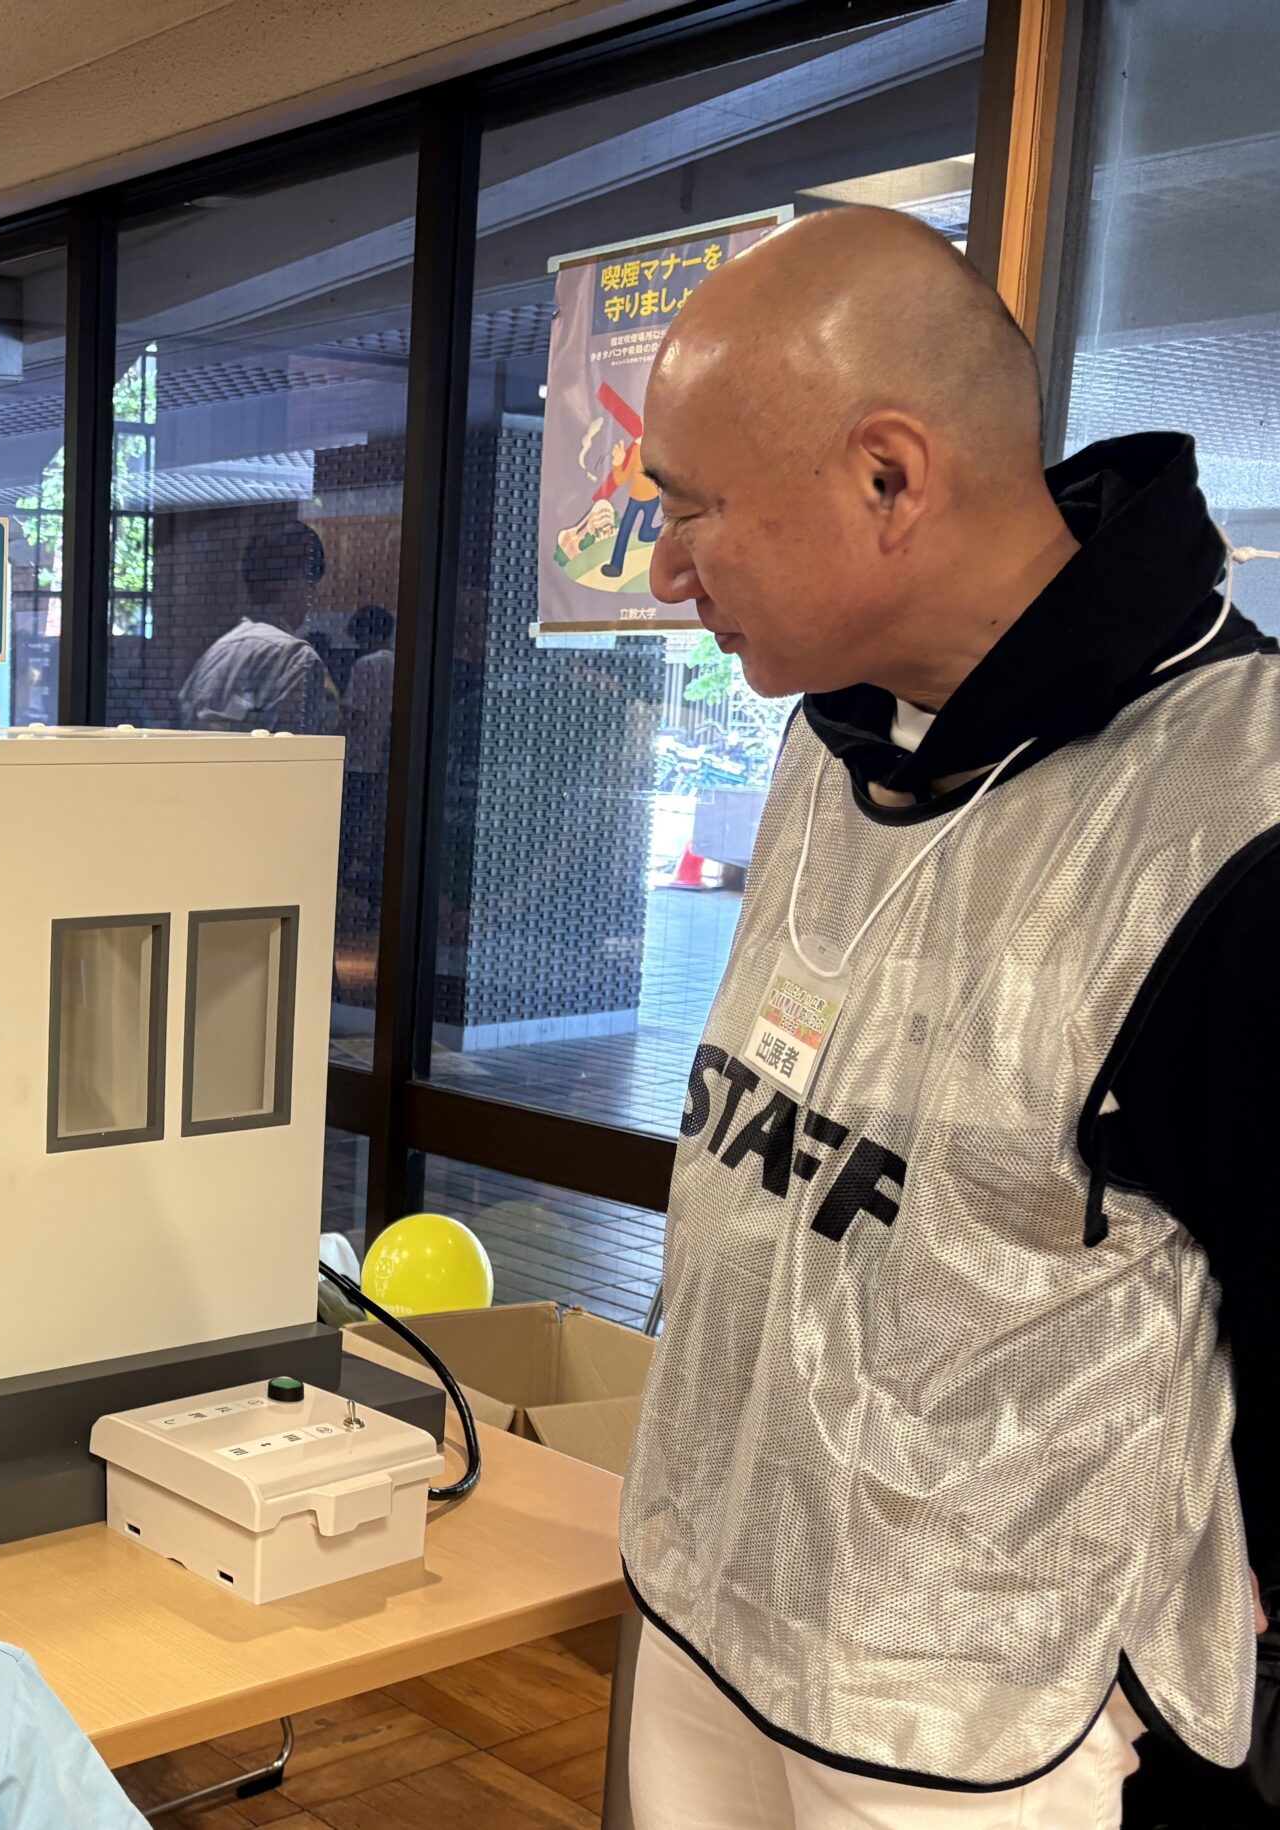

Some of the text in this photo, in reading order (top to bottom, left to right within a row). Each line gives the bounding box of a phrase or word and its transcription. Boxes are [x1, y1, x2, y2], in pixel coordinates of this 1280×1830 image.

[601, 243, 723, 292] 喫煙マナーを
[604, 287, 695, 323] 守りましょ
[619, 607, 657, 620] 立教大学
[755, 1030, 801, 1079] 出展者
